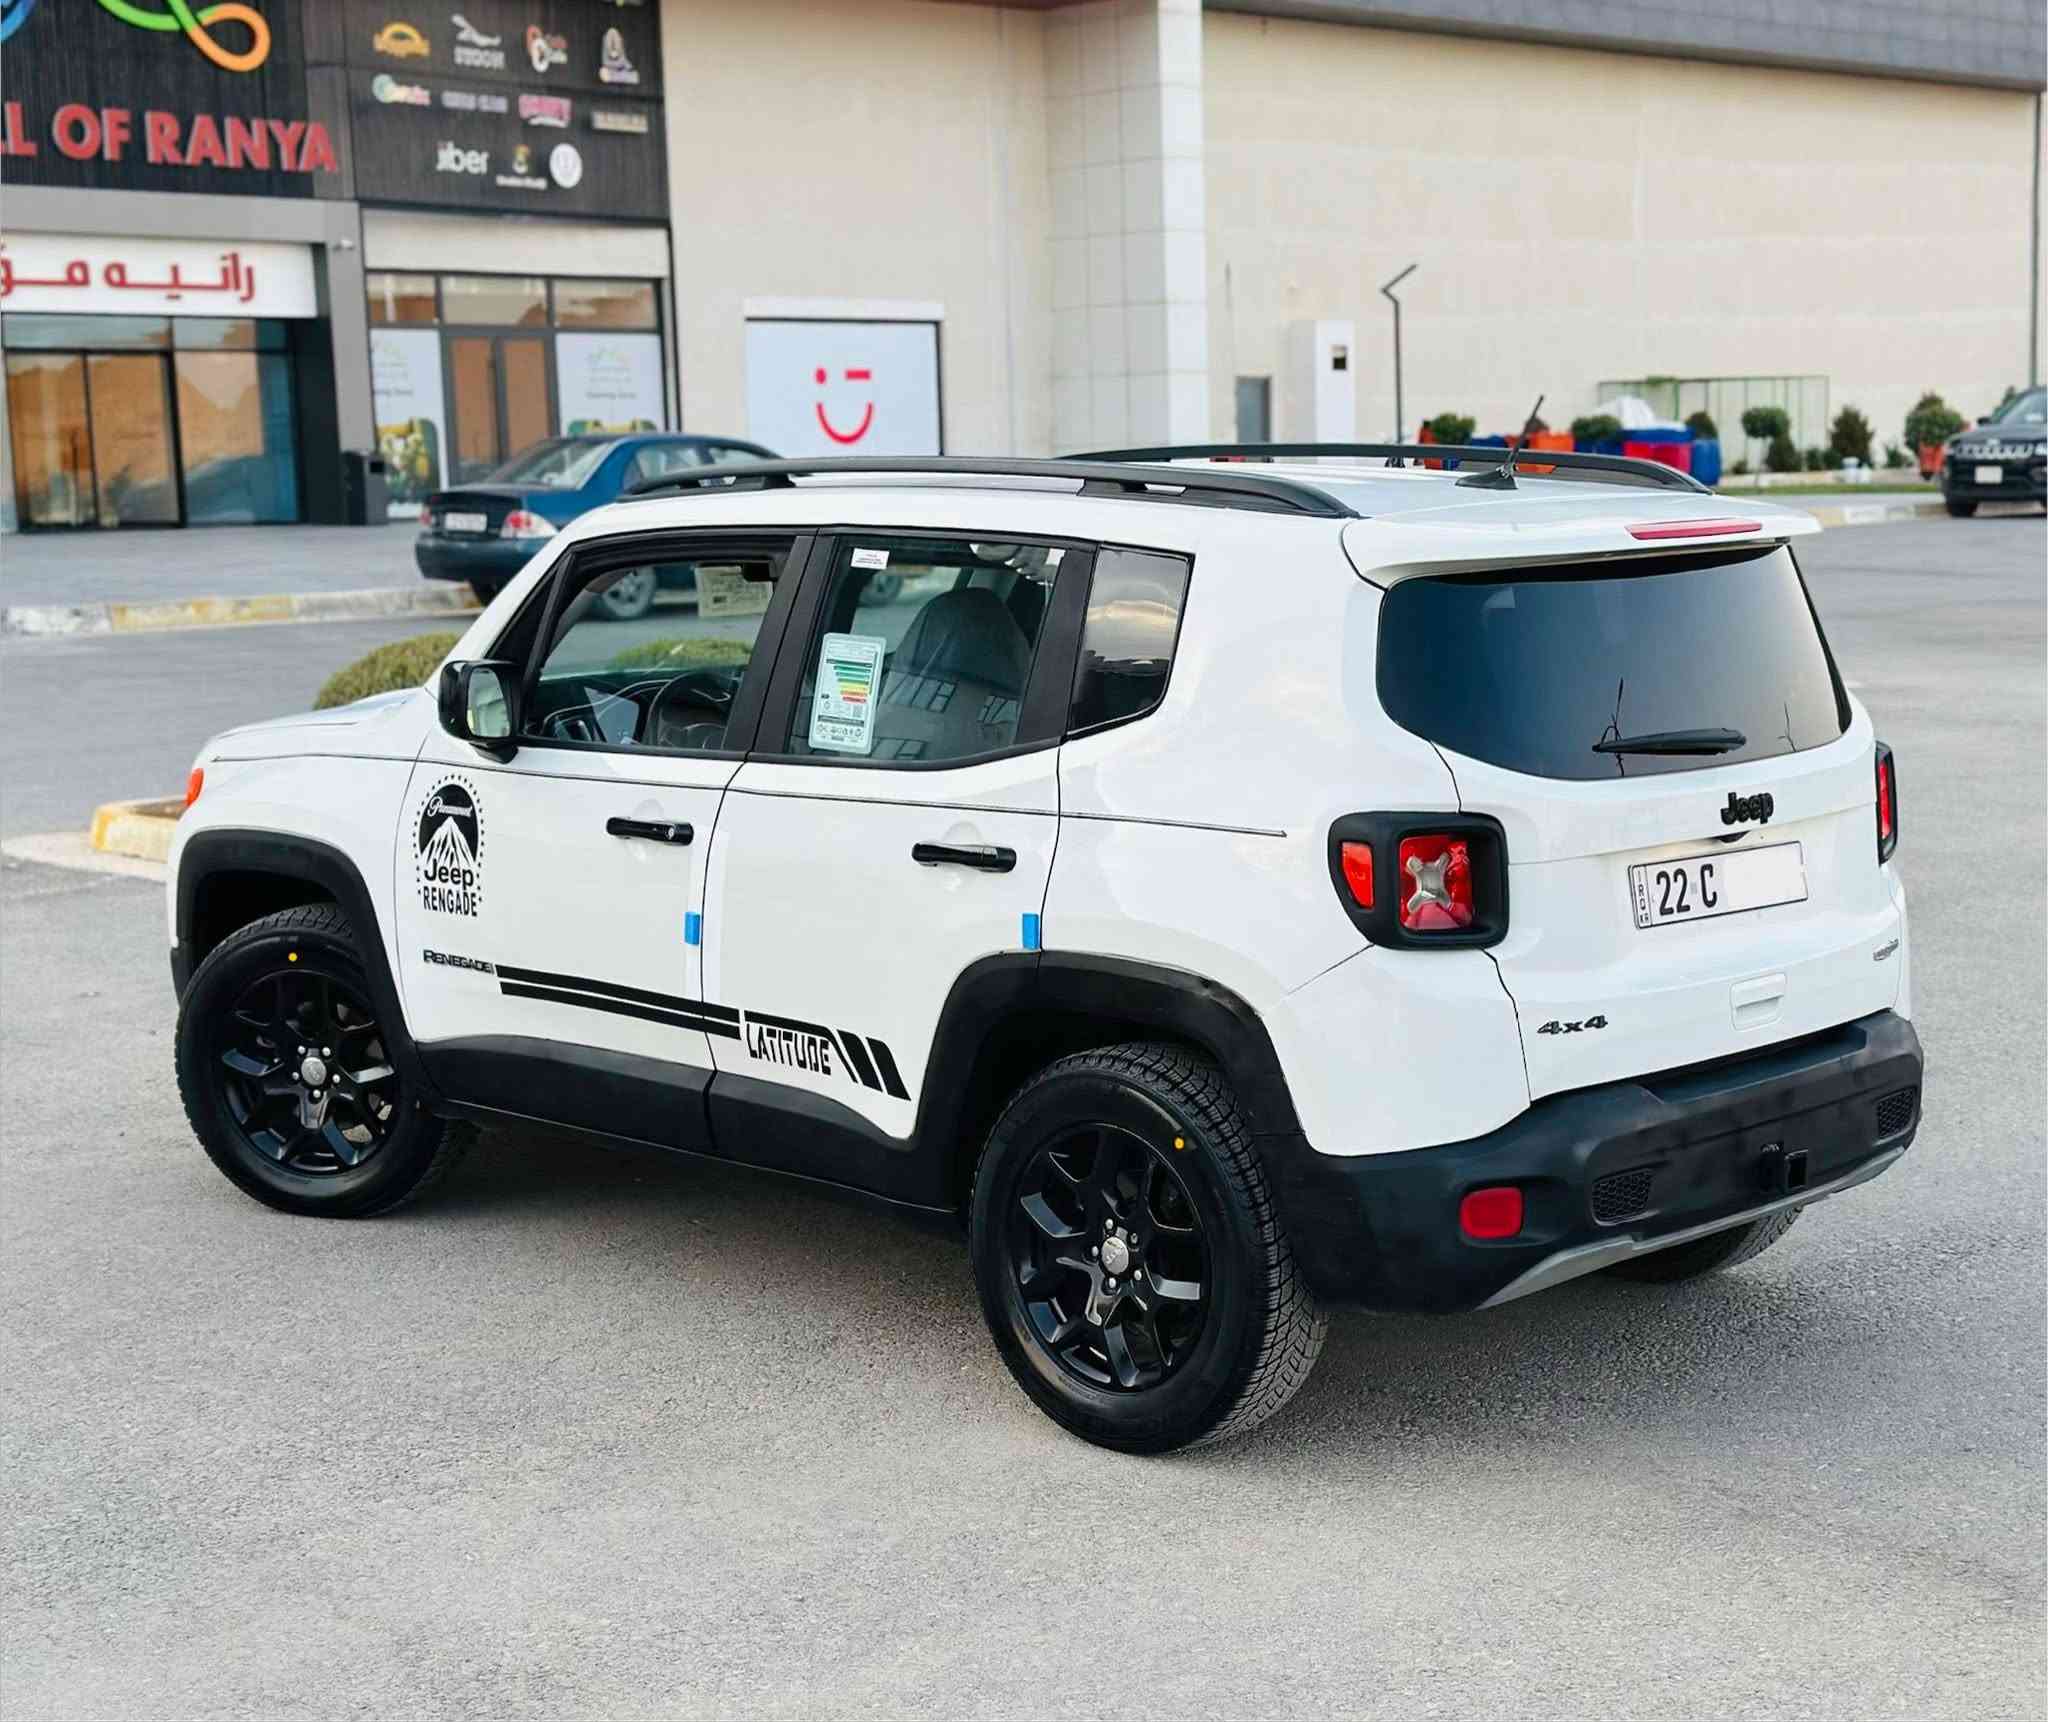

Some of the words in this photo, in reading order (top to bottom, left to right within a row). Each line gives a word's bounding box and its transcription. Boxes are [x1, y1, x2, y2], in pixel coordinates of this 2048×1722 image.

[52, 103, 132, 161] OF
[144, 111, 338, 172] RANYA
[1720, 791, 1774, 825] Jeep
[424, 858, 475, 890] Jeep
[1656, 868, 1691, 916] 22
[1700, 863, 1717, 908] C
[423, 885, 478, 917] RENGADE
[746, 1022, 831, 1076] LATITUDE
